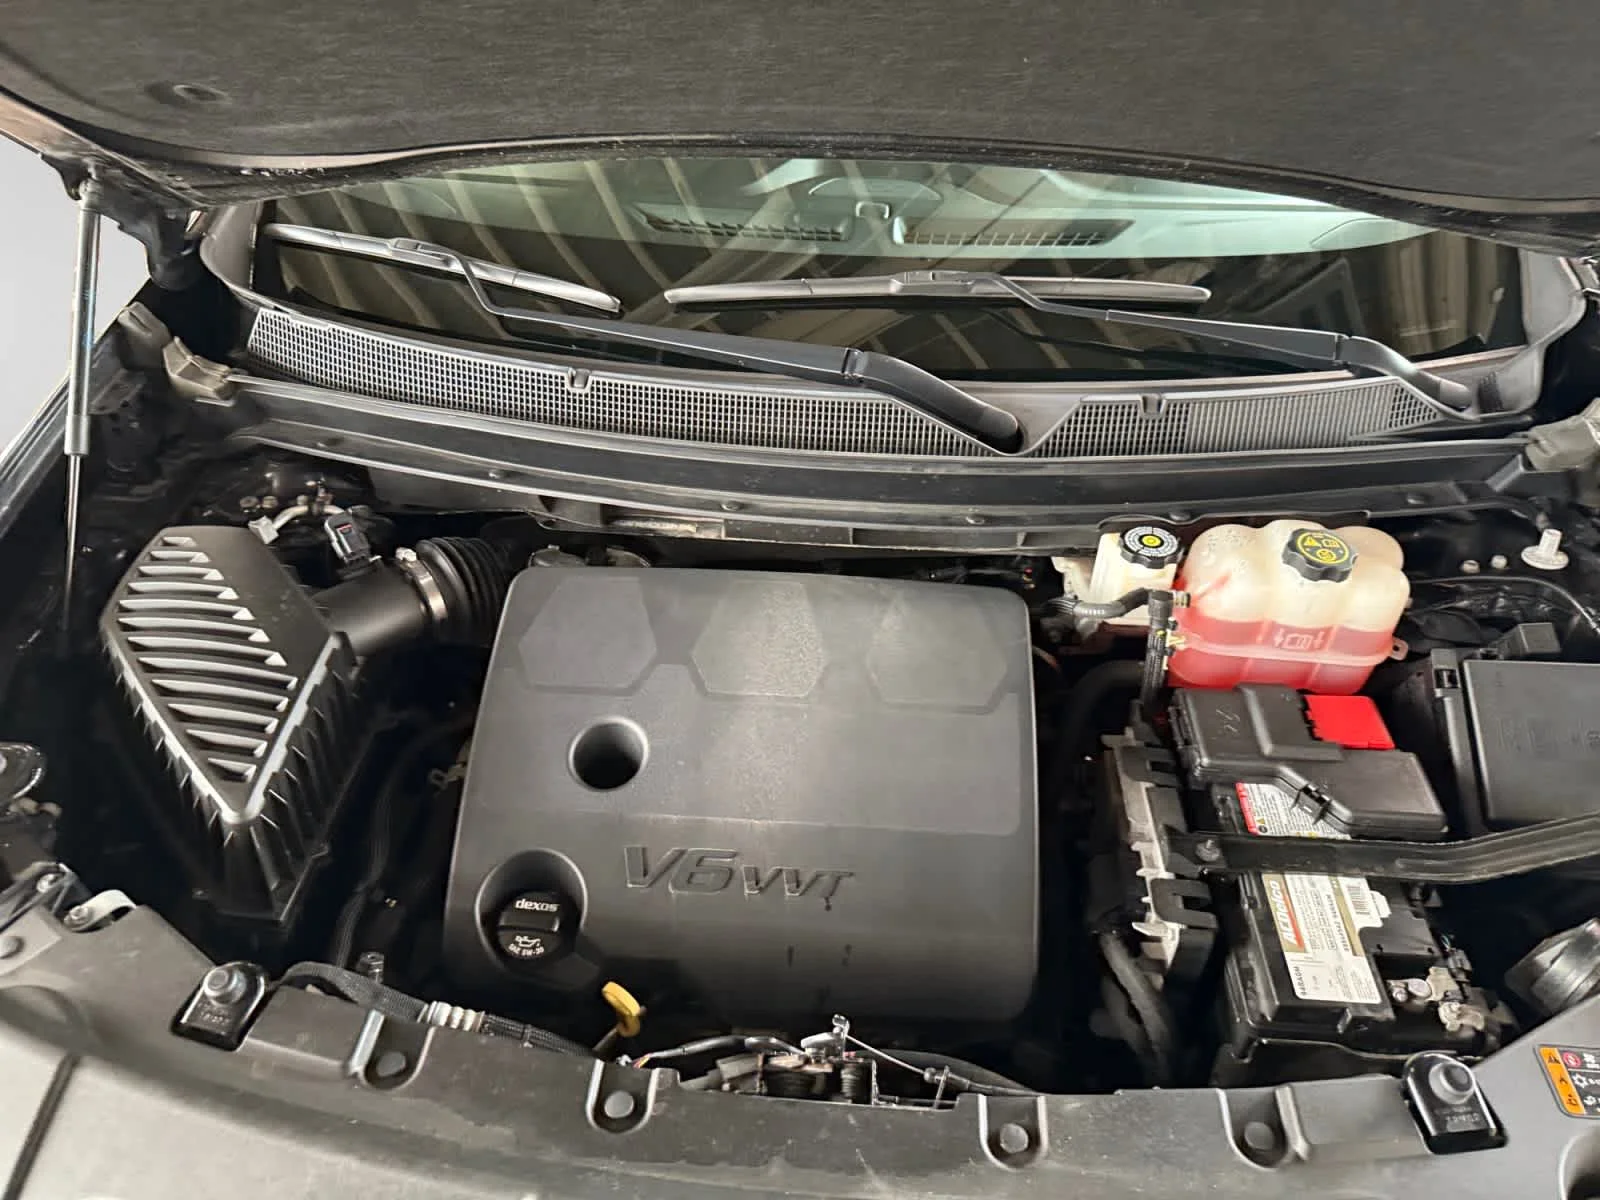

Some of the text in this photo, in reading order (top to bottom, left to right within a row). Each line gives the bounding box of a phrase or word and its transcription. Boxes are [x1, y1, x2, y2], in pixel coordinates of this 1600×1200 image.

[623, 845, 854, 898] V6 VVT
[514, 898, 560, 913] dexos
[1269, 880, 1298, 945] ACDelco
